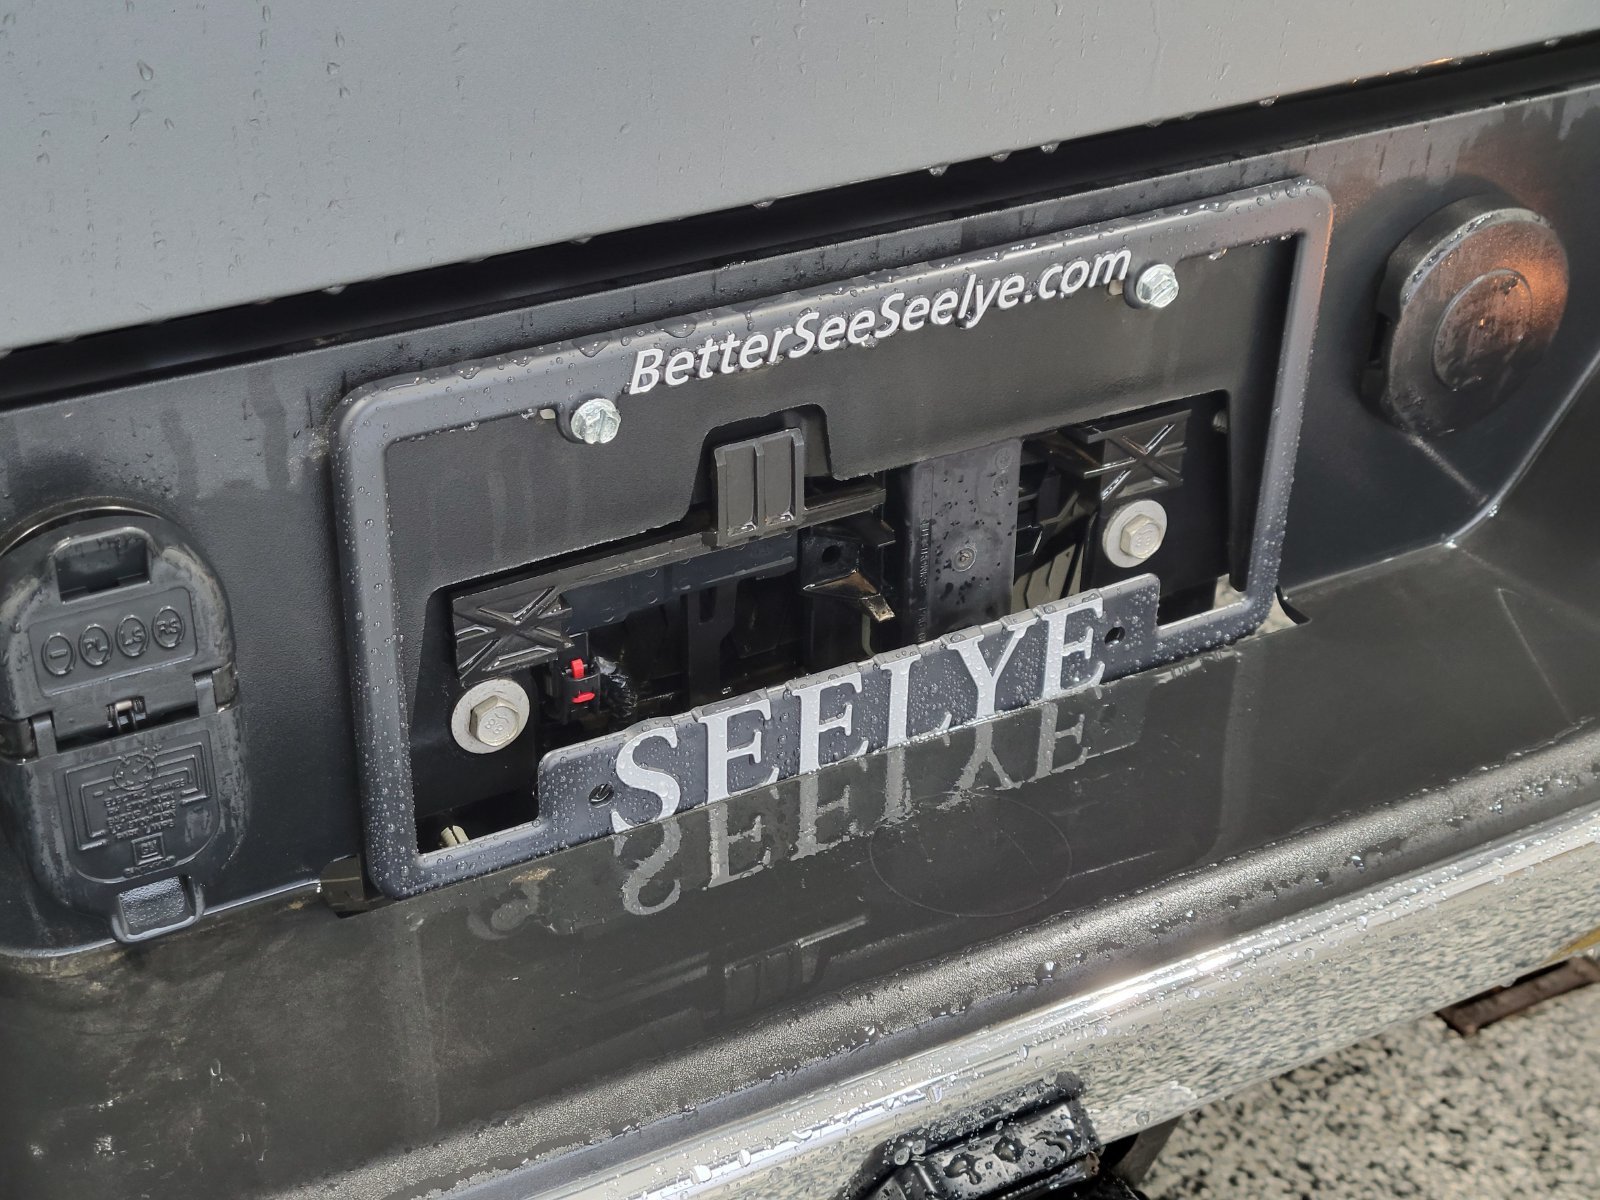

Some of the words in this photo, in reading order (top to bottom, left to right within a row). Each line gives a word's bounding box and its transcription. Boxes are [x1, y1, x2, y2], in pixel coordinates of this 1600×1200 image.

[629, 249, 1132, 394] BetterSeeSeelye.com
[120, 626, 144, 646] LS
[156, 617, 181, 637] RS
[611, 596, 1104, 834] SEELYE
